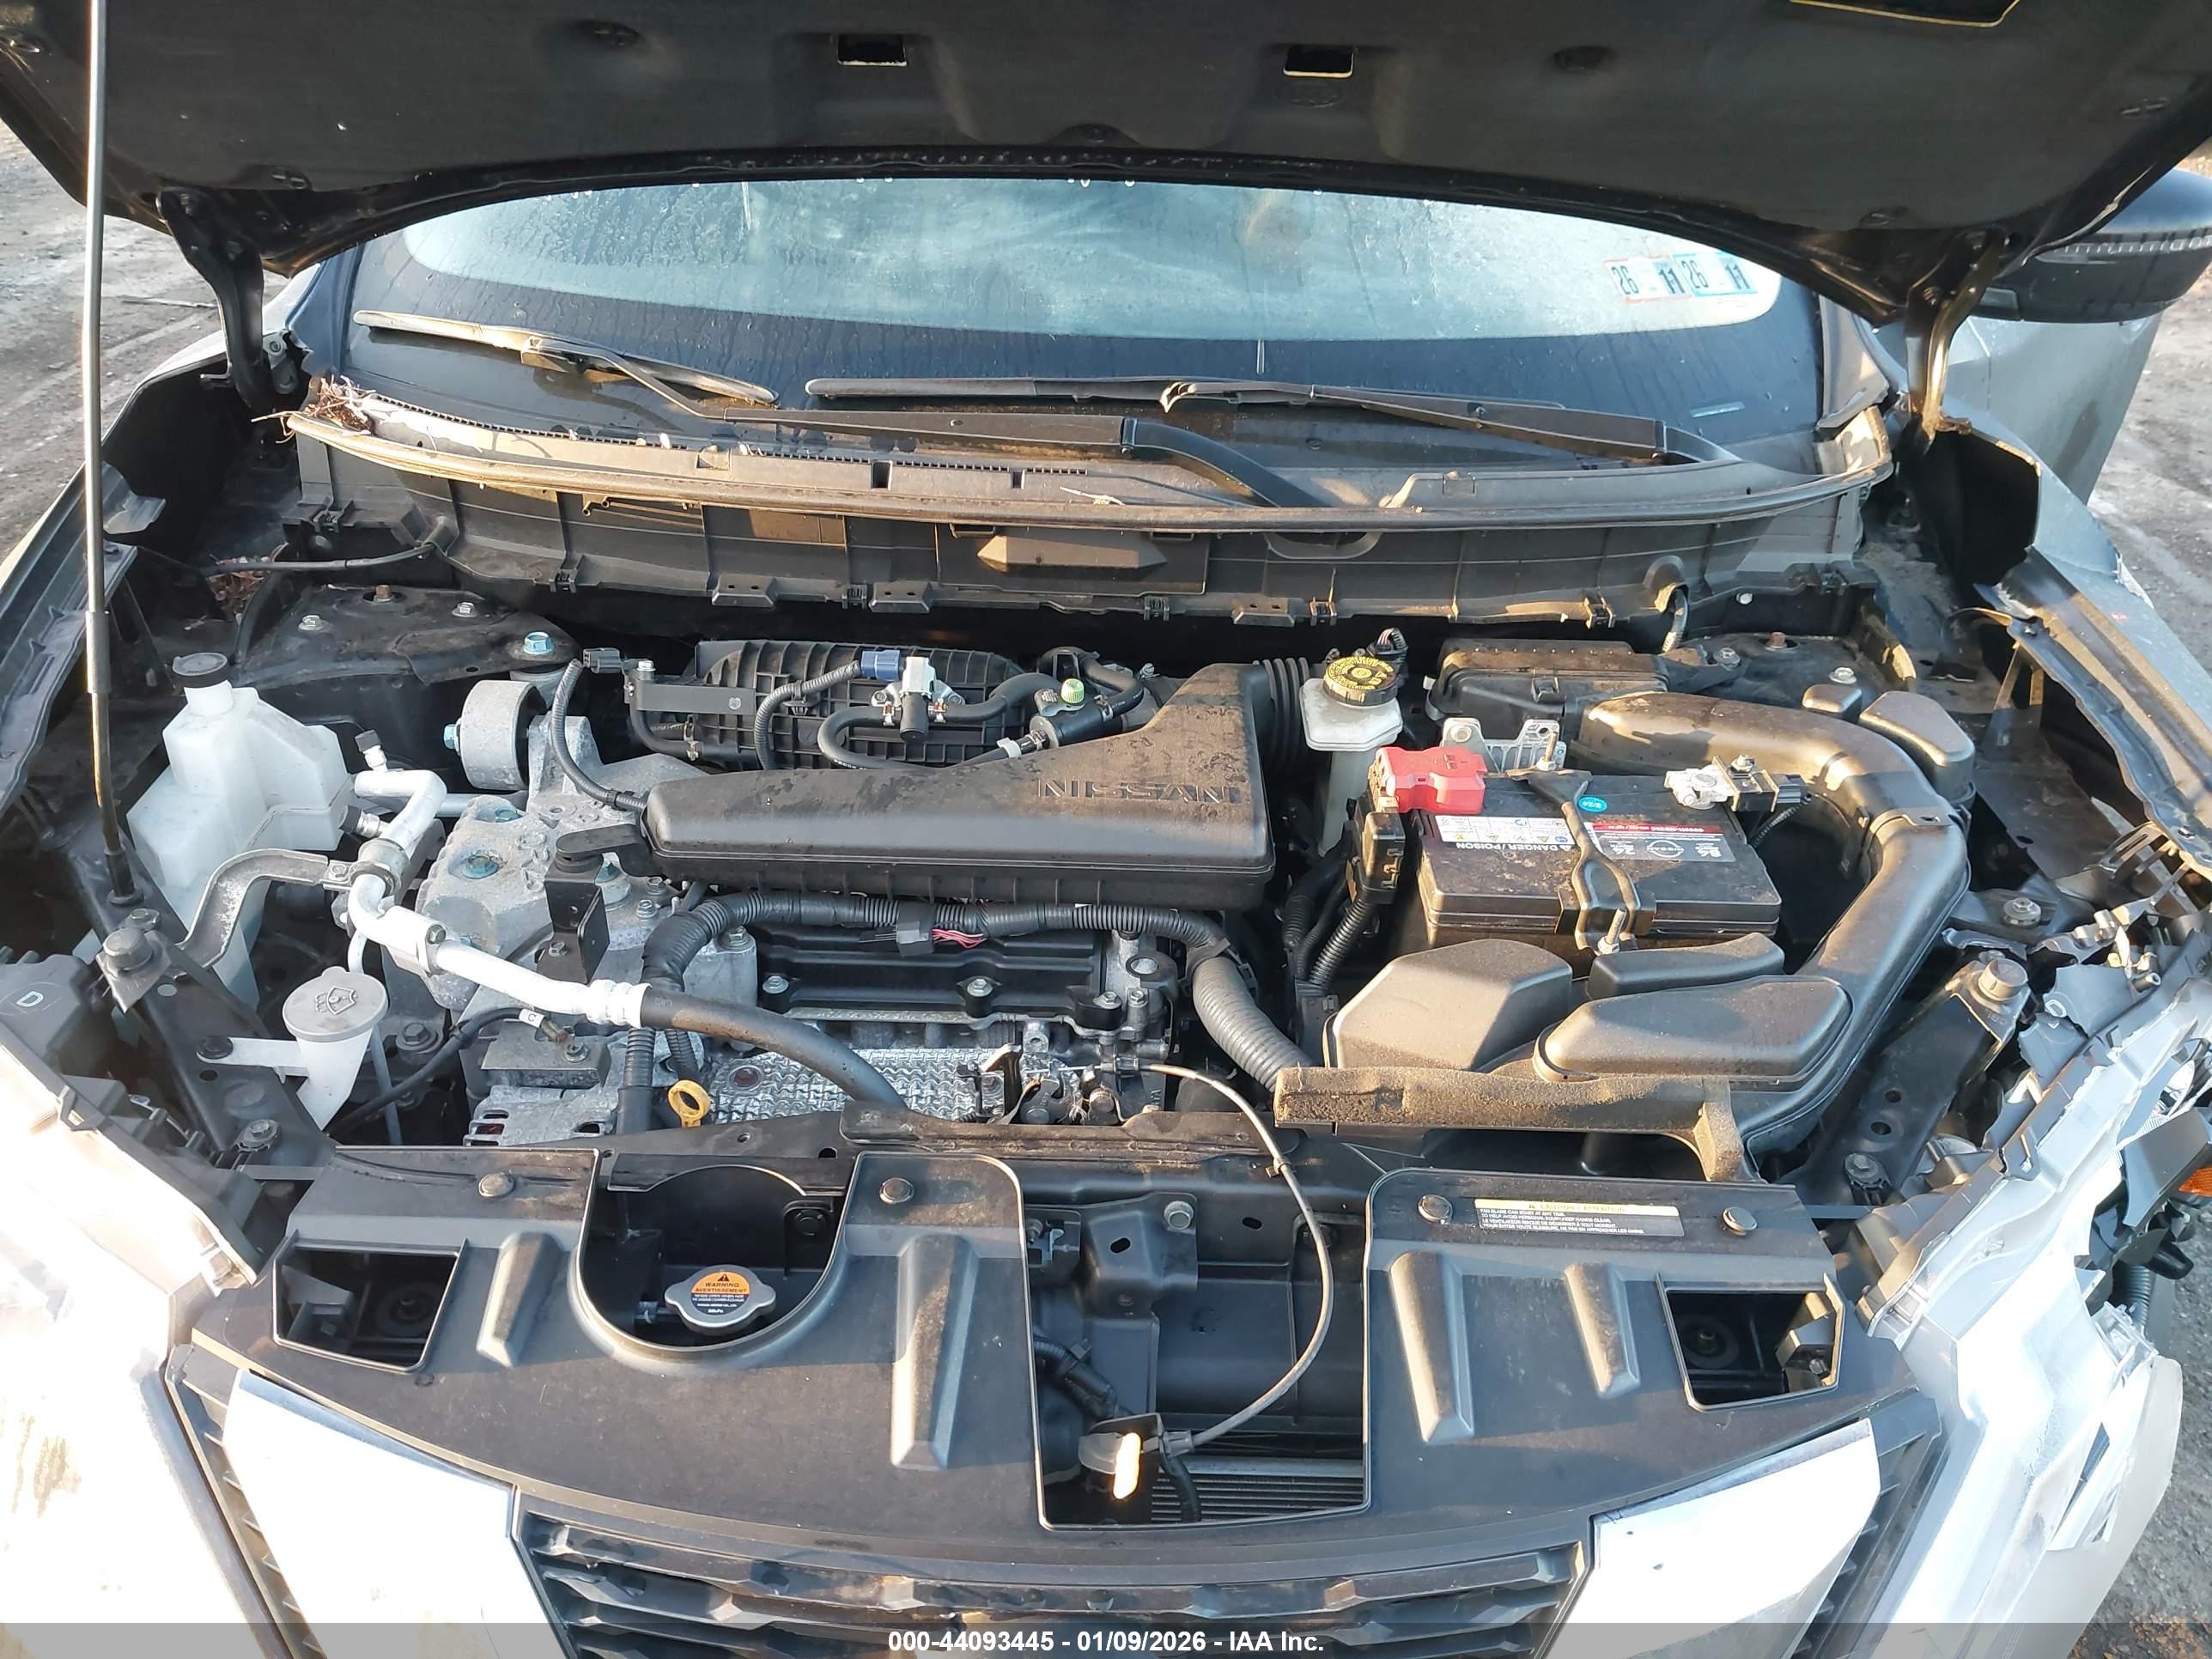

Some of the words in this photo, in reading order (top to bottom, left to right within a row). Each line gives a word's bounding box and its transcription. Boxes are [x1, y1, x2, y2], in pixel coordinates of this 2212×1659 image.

[1611, 265, 1639, 295] 26
[1658, 268, 1686, 295] 11
[1680, 260, 1709, 289] 26
[1724, 264, 1751, 289] 11
[1037, 778, 1243, 804] NISSAN
[1509, 843, 1559, 852] DANGER
[527, 1013, 537, 1023] C
